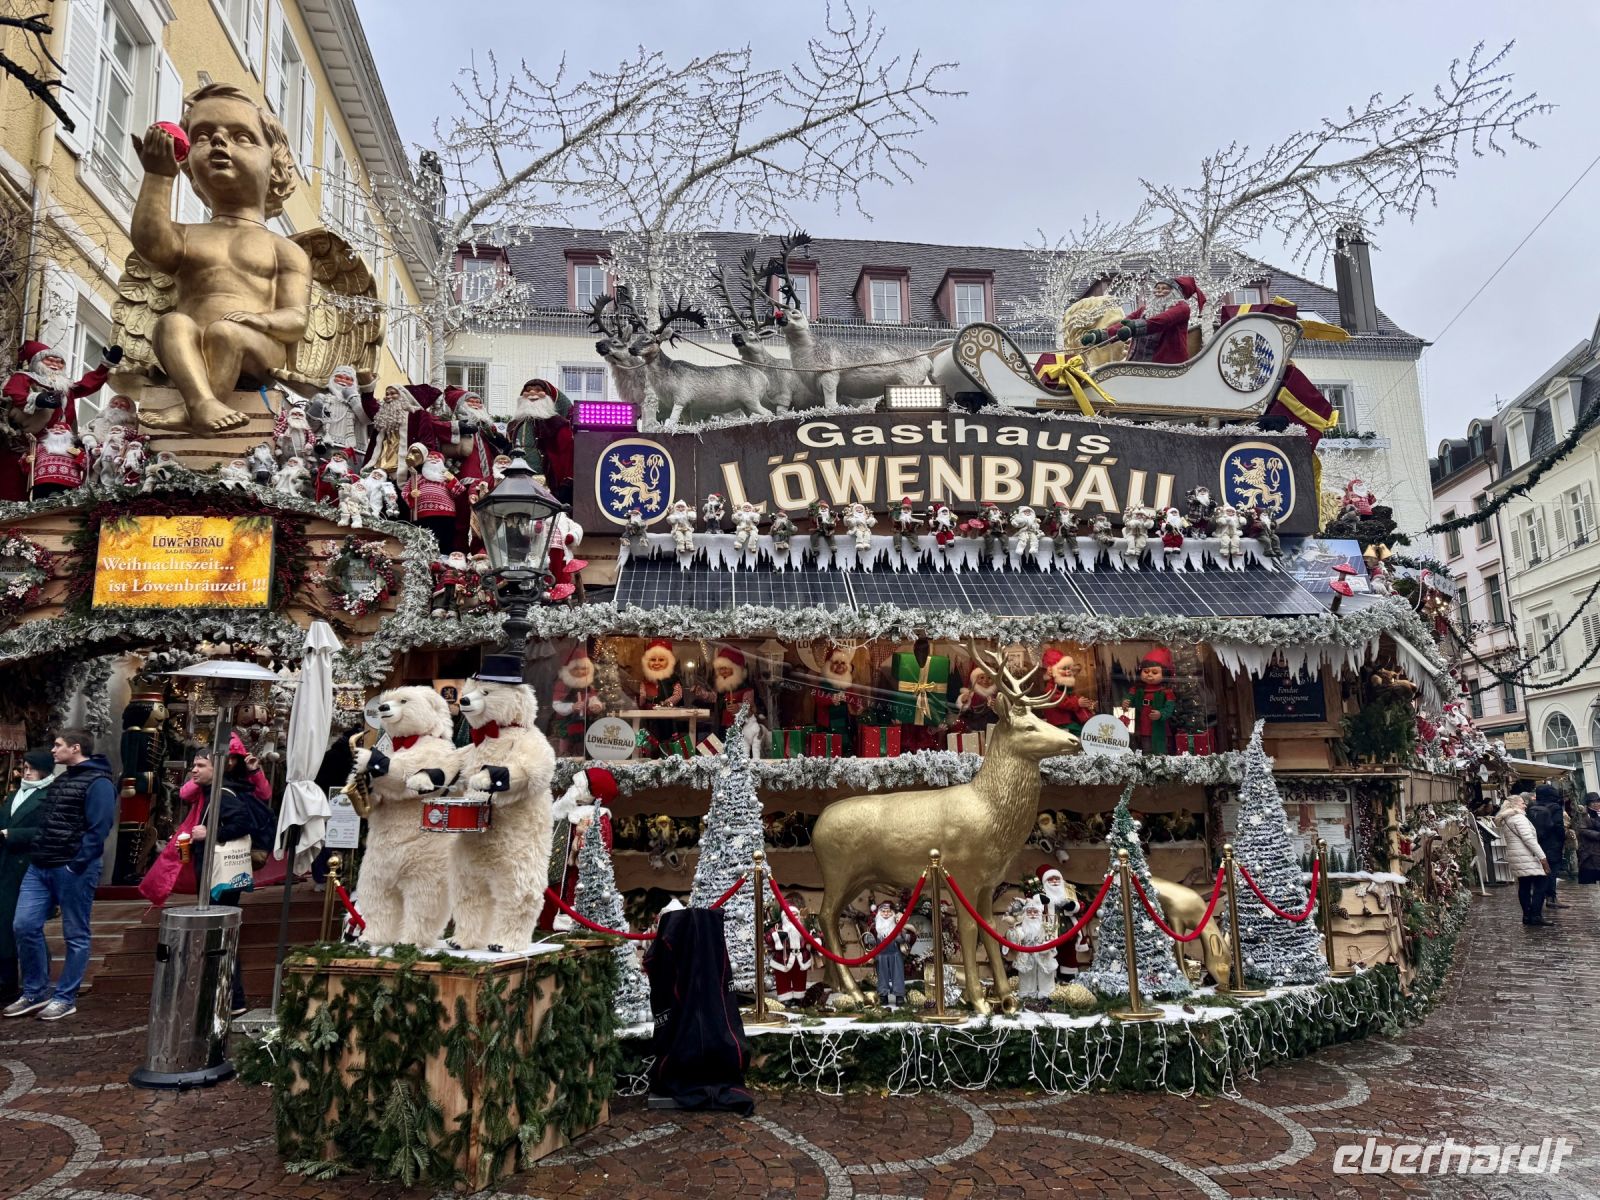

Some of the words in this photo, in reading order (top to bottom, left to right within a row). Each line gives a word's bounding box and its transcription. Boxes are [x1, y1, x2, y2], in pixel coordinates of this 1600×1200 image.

[796, 418, 1112, 454] Gasthaus
[720, 451, 1176, 514] LÖWENBRÄU
[152, 535, 225, 548] LÖWENBRÄU
[101, 556, 235, 571] Weihnachtszeit...
[108, 579, 128, 592] ist
[132, 578, 247, 592] Löwenbräuzeit
[587, 734, 634, 748] LÖWENBRÄU
[1082, 731, 1128, 748] LÖWENBRÄU
